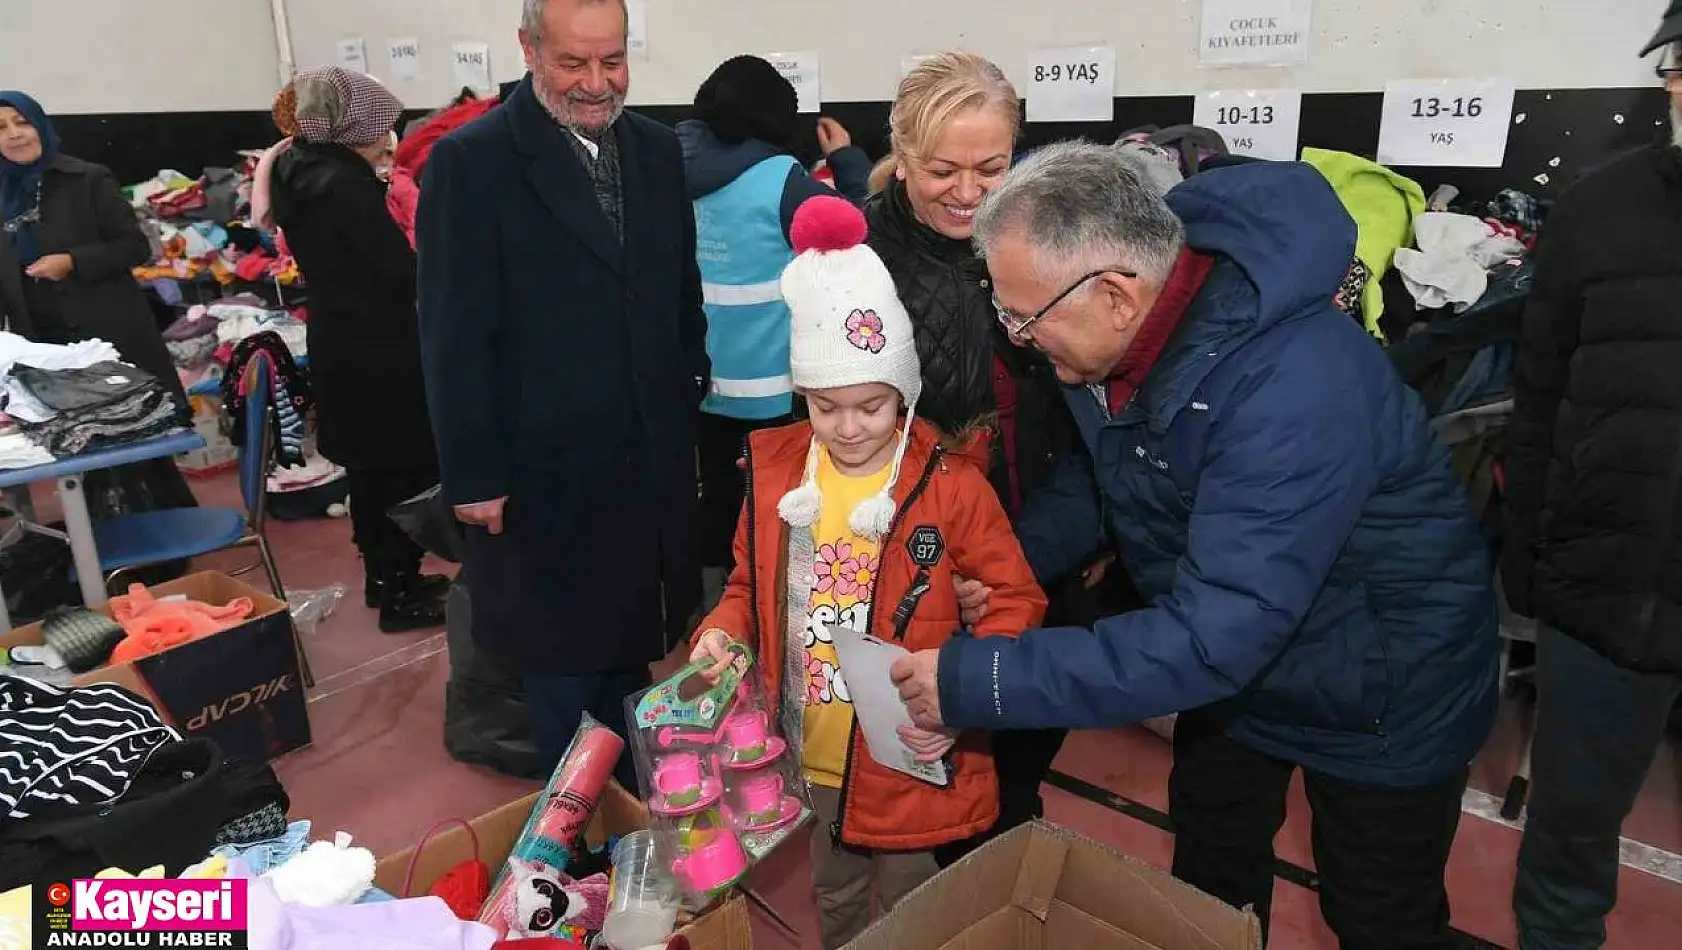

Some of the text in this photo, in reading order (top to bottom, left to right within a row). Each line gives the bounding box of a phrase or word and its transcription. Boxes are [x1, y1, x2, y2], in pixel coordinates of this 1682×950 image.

[1035, 63, 1099, 83] 8-9 YAŞ
[1217, 106, 1274, 125] 10-13
[1411, 97, 1483, 118] 13-16
[1232, 139, 1253, 149] YAŞ
[1430, 132, 1454, 145] YAŞ
[916, 544, 936, 559] 97
